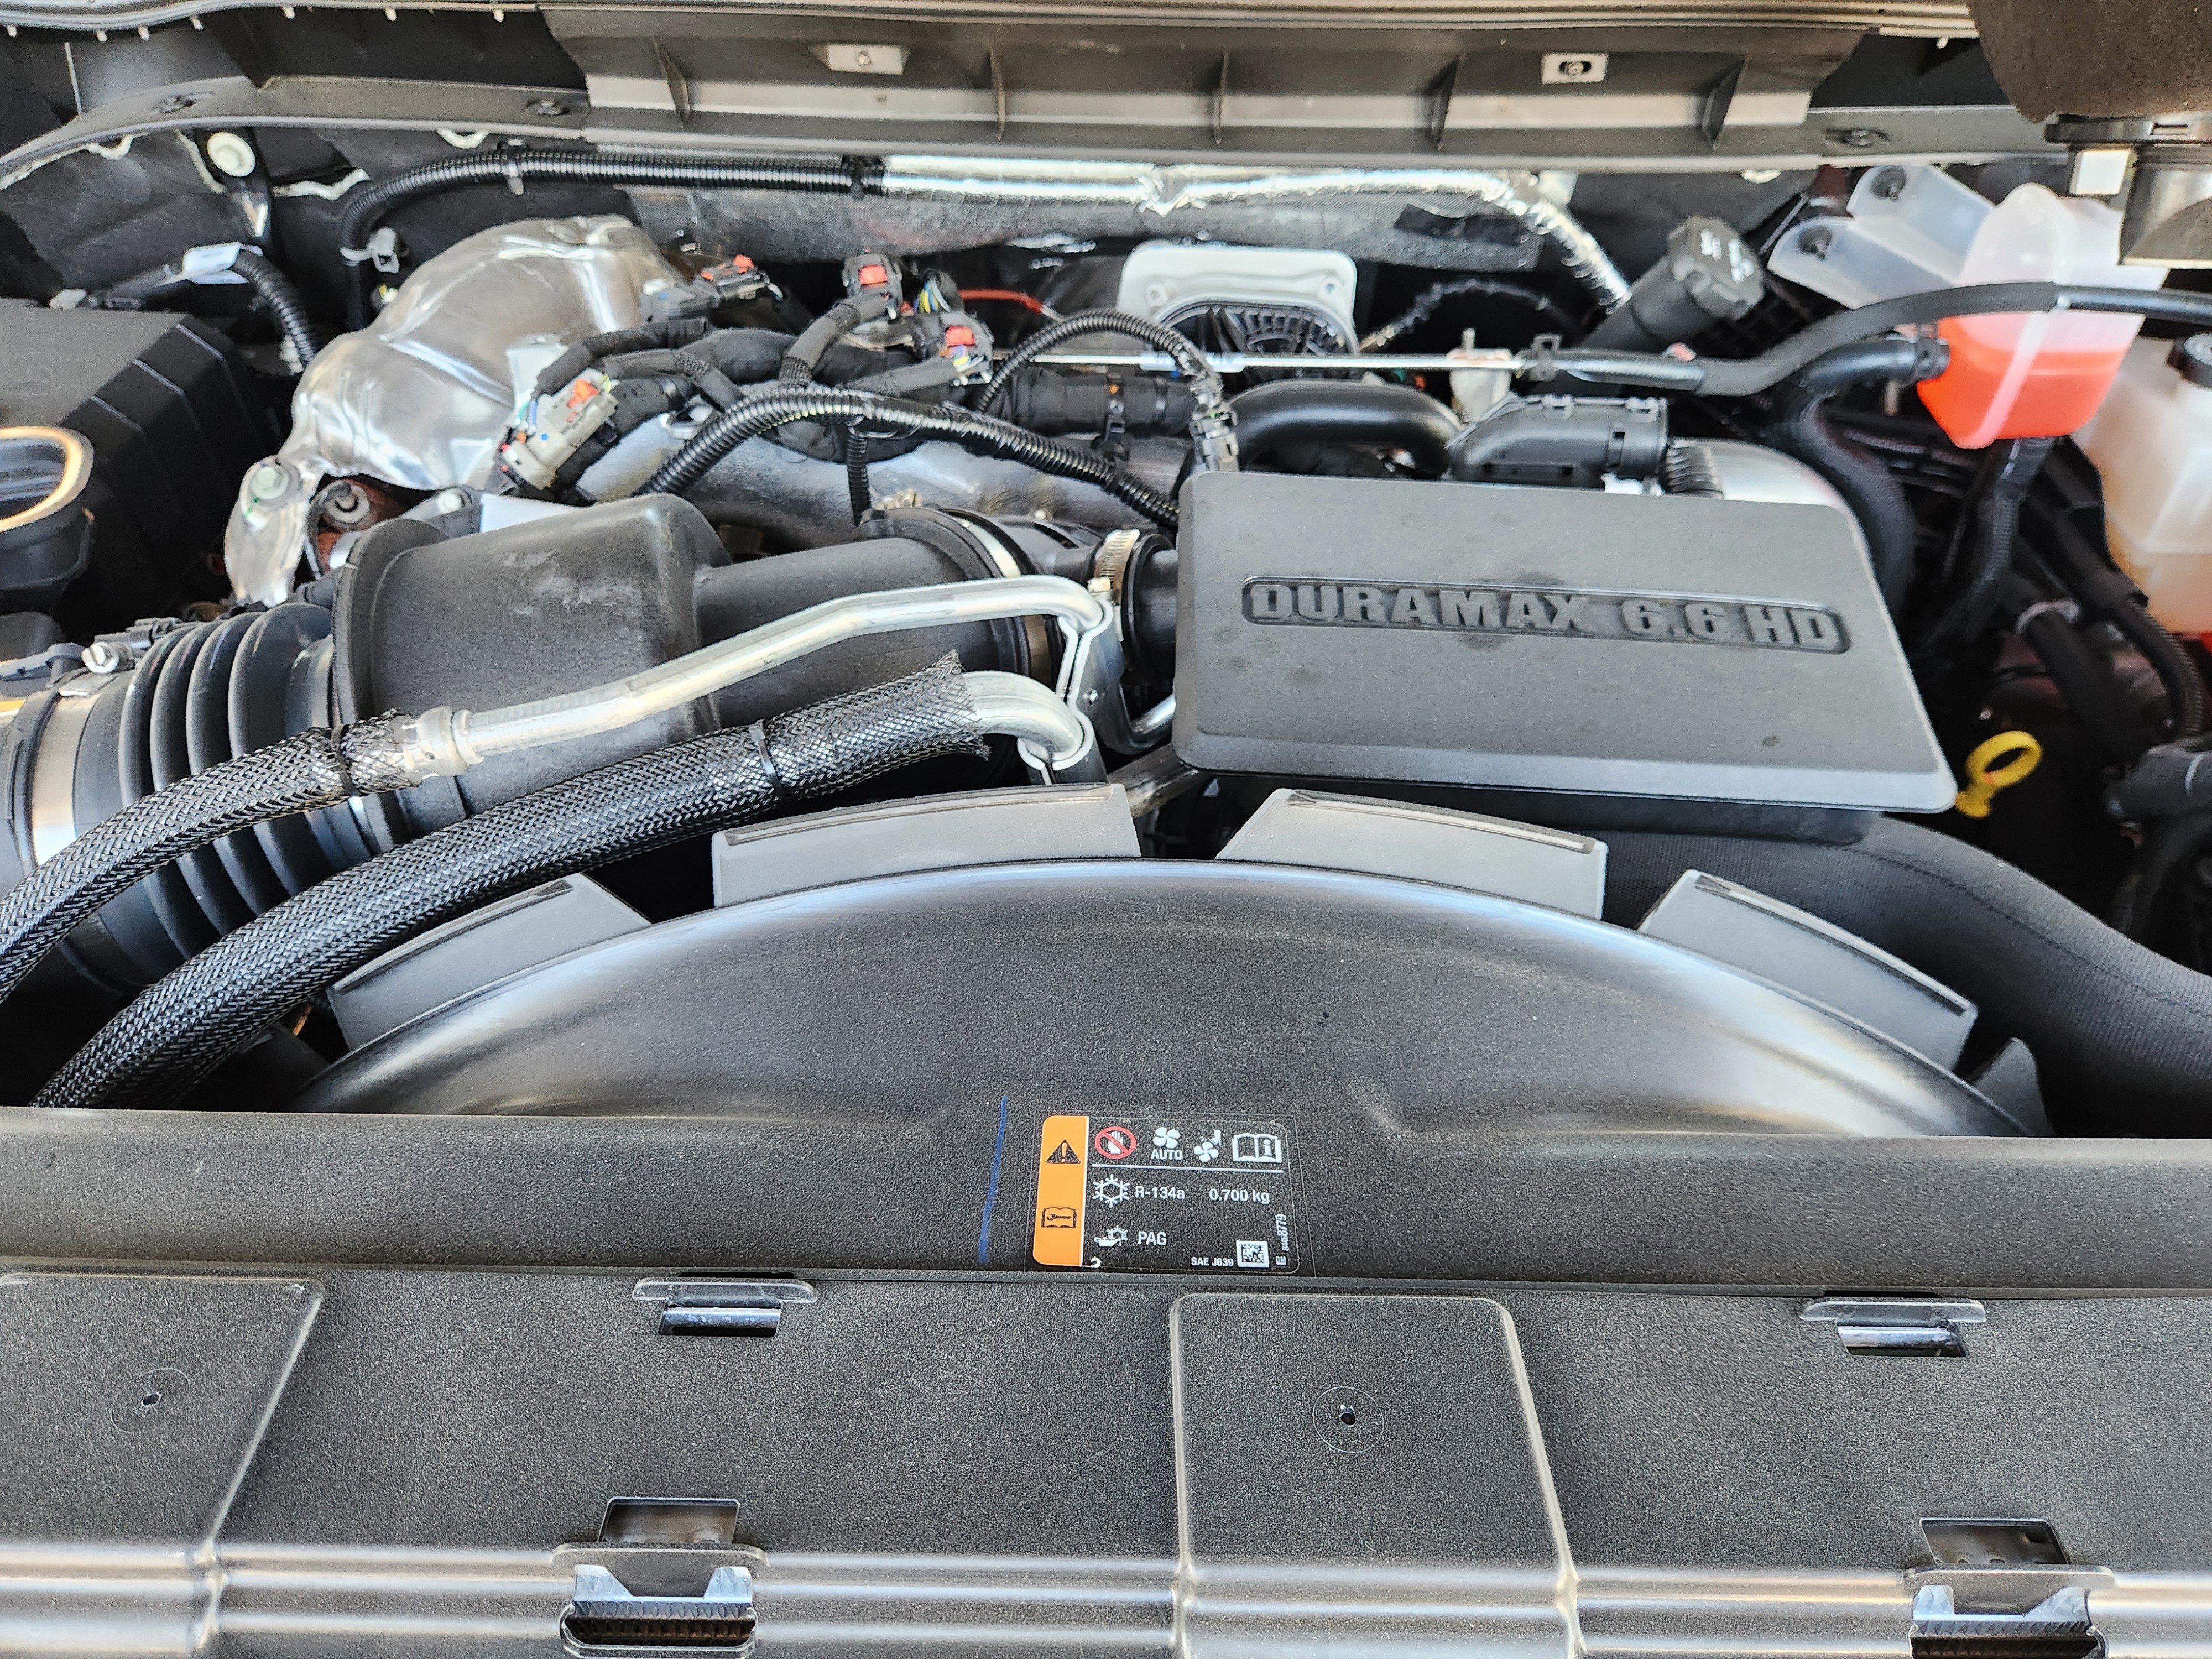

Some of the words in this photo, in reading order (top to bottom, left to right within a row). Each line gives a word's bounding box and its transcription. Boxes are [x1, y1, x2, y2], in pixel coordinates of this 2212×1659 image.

[1250, 583, 1593, 632] DURAMAX
[1620, 598, 1731, 640] 6.6
[1744, 607, 1841, 652] HD
[1151, 1149, 1183, 1161] AUTO
[1135, 1185, 1186, 1200] R-134a
[1209, 1188, 1249, 1202] 0.700
[1252, 1189, 1270, 1205] kg
[1138, 1230, 1167, 1246] PAG
[1191, 1256, 1210, 1266] SAE
[1211, 1257, 1234, 1267] J639
